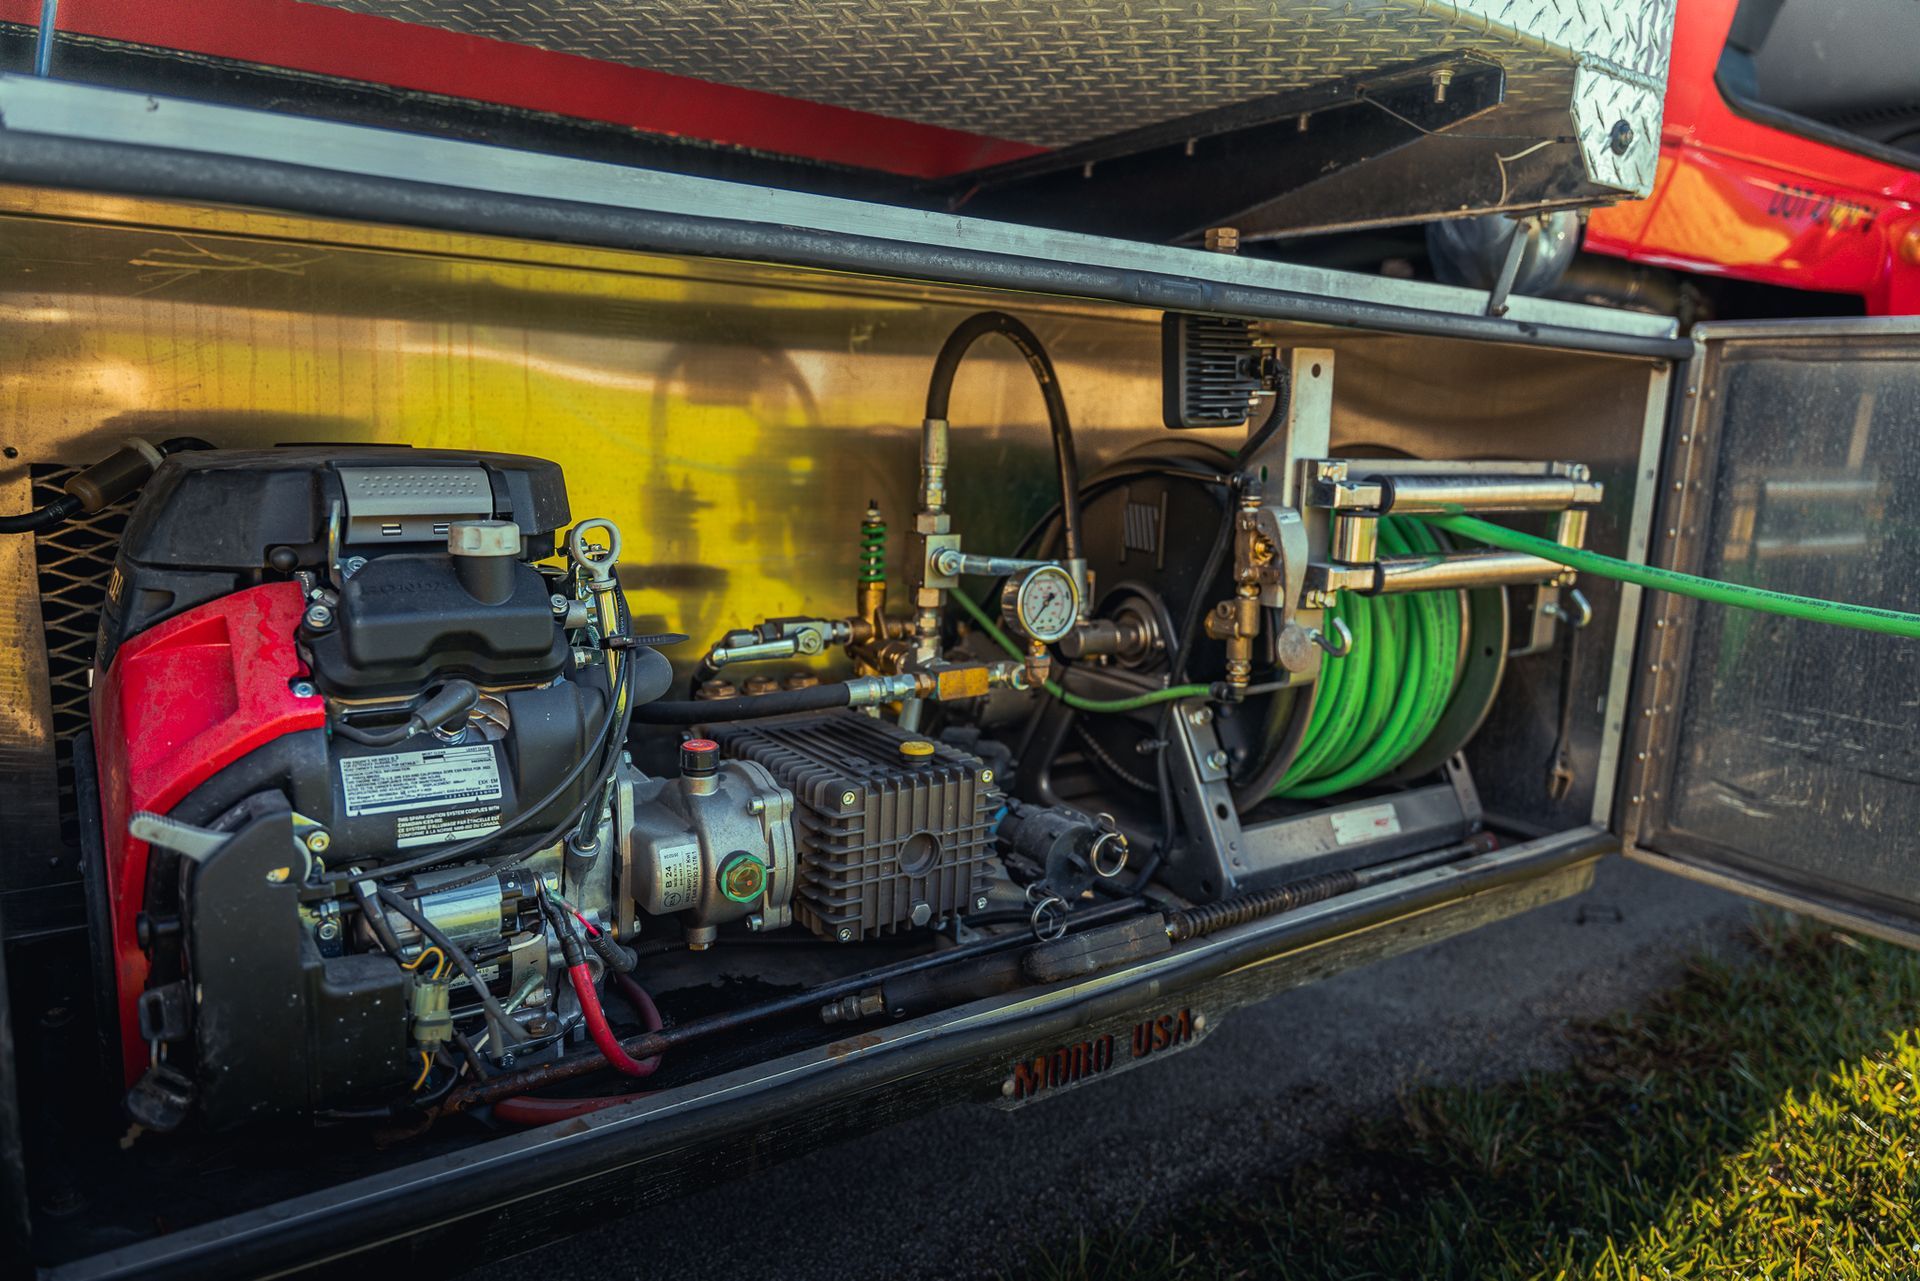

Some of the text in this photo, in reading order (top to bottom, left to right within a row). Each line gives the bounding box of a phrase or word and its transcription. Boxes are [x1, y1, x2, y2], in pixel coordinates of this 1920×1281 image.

[1836, 604, 1860, 612] HOSE
[465, 806, 487, 814] COMPLIES
[665, 866, 672, 877] 24
[665, 880, 672, 888] B
[1013, 1007, 1193, 1100] MORO USA
